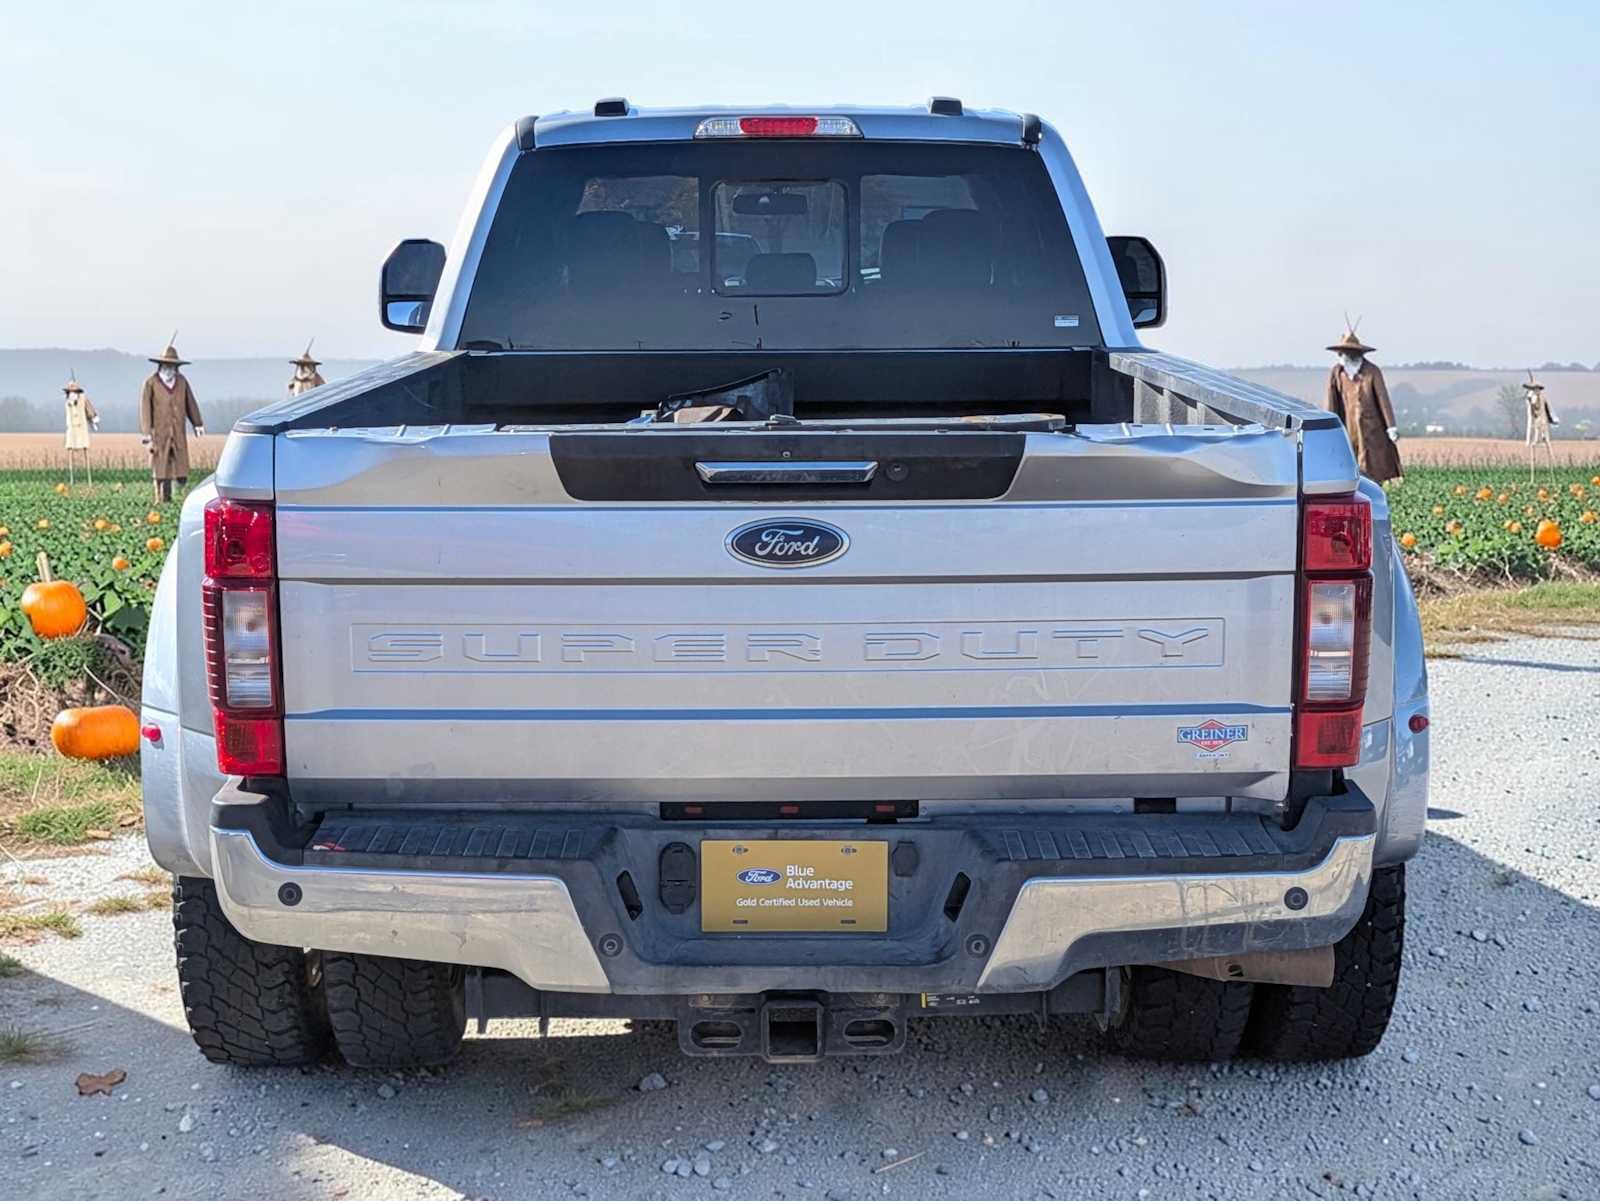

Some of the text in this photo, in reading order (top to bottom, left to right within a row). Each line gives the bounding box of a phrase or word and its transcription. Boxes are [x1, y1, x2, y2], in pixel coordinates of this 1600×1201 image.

[754, 528, 821, 556] Ford
[367, 628, 1209, 663] SUPER DUTY
[1179, 727, 1245, 741] GREINER
[745, 869, 774, 883] Ford
[786, 864, 815, 877] Blue
[785, 878, 854, 892] Advantage
[735, 897, 854, 907] Gold Certified Used Vehicle
